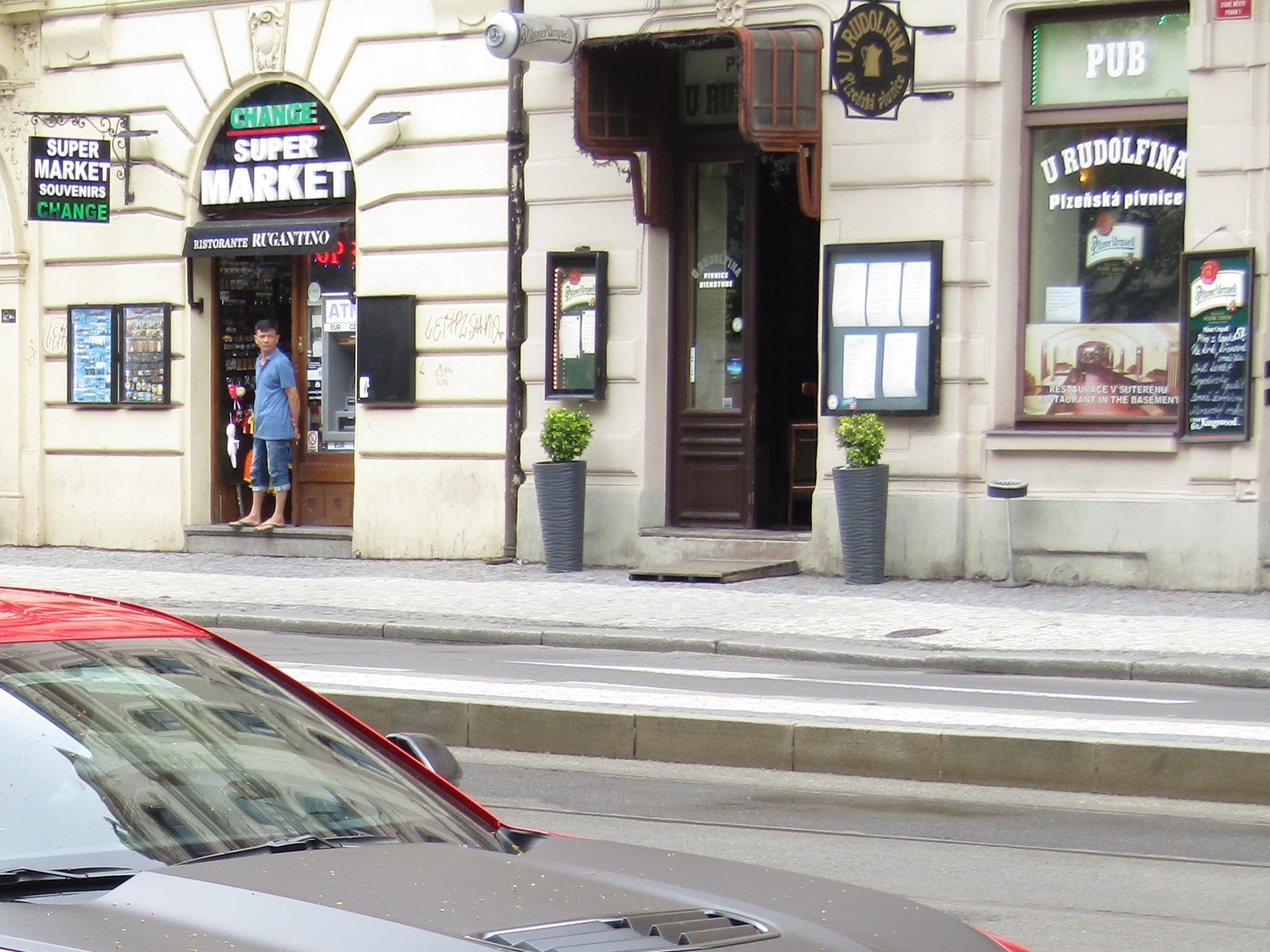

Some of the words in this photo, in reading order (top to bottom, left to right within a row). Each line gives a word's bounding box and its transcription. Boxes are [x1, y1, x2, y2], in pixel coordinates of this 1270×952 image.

[841, 10, 908, 65] RUDOLFINA
[836, 50, 854, 63] U
[1085, 40, 1145, 79] PUB
[230, 102, 318, 129] CHANGE
[46, 138, 100, 159] SUPER
[233, 135, 319, 163] SUPER
[34, 158, 111, 182] MARKET
[1040, 155, 1059, 184] U
[1061, 136, 1188, 180] RUDOLFINA
[39, 182, 107, 199] SOUVENIRS
[201, 161, 353, 206] MARKET
[1049, 190, 1120, 211] Plzeňská
[1124, 188, 1184, 210] pivnice
[37, 200, 108, 221] CHANGE
[193, 237, 249, 250] RISTORANTE
[252, 229, 330, 248] RUGANTINO
[699, 280, 733, 289] BIERSTUBE
[703, 272, 729, 280] PIVNICE
[1049, 385, 1108, 394] RESTAURACE
[1110, 385, 1116, 393] V
[1119, 385, 1168, 394] SUTERENU
[1038, 396, 1096, 404] RESTAURANT
[1110, 396, 1128, 404] THE
[1131, 396, 1179, 405] BASEMENT
